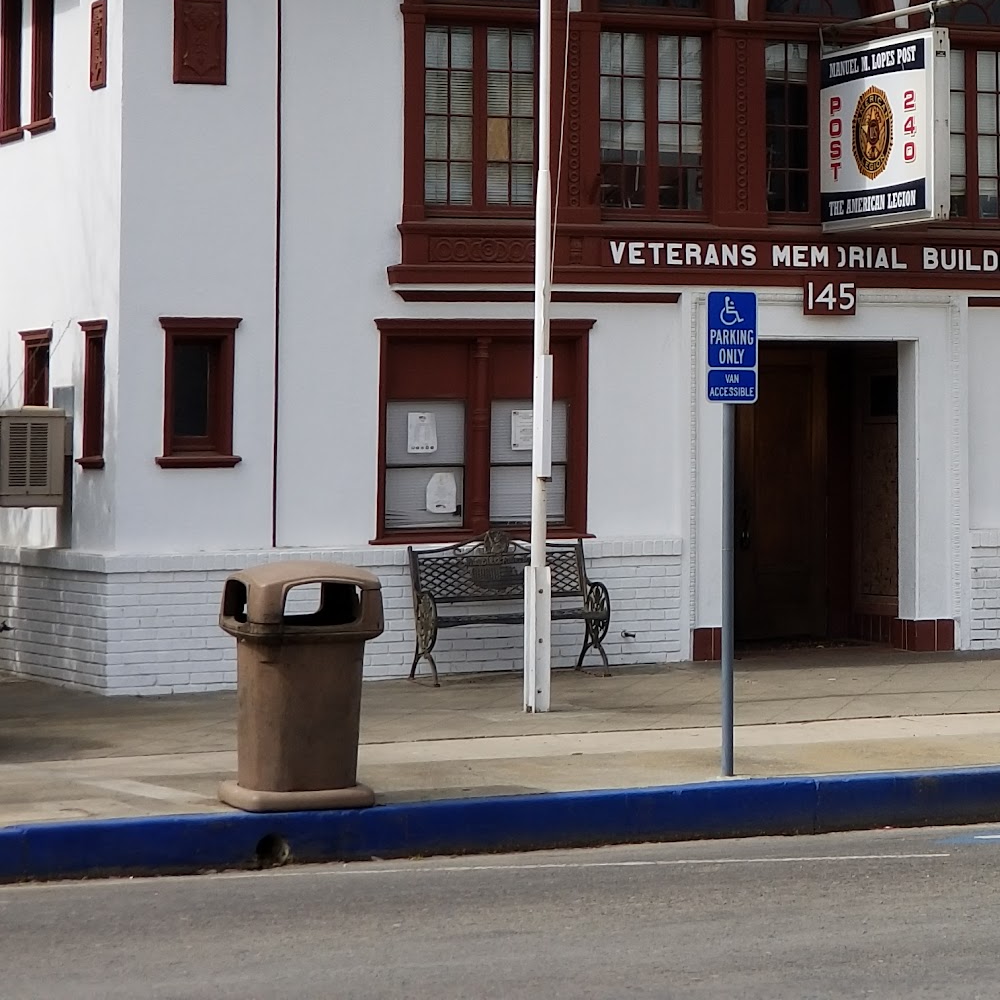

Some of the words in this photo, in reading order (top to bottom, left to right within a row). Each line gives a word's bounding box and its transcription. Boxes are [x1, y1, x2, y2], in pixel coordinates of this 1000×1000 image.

[829, 58, 859, 78] MANUEL
[861, 56, 870, 72] M.
[871, 50, 895, 70] LOPES
[896, 45, 916, 65] POST
[829, 97, 842, 182] POST
[904, 90, 916, 163] 240
[829, 200, 844, 216] THE
[846, 194, 885, 214] AMERICAN
[887, 189, 916, 209] LEGION
[609, 241, 757, 266] VETERANS
[807, 281, 855, 310] 145
[710, 329, 754, 345] PARKING
[719, 348, 745, 364] ONLY
[725, 374, 739, 383] VAN
[709, 387, 754, 397] ACCESSIBLE
